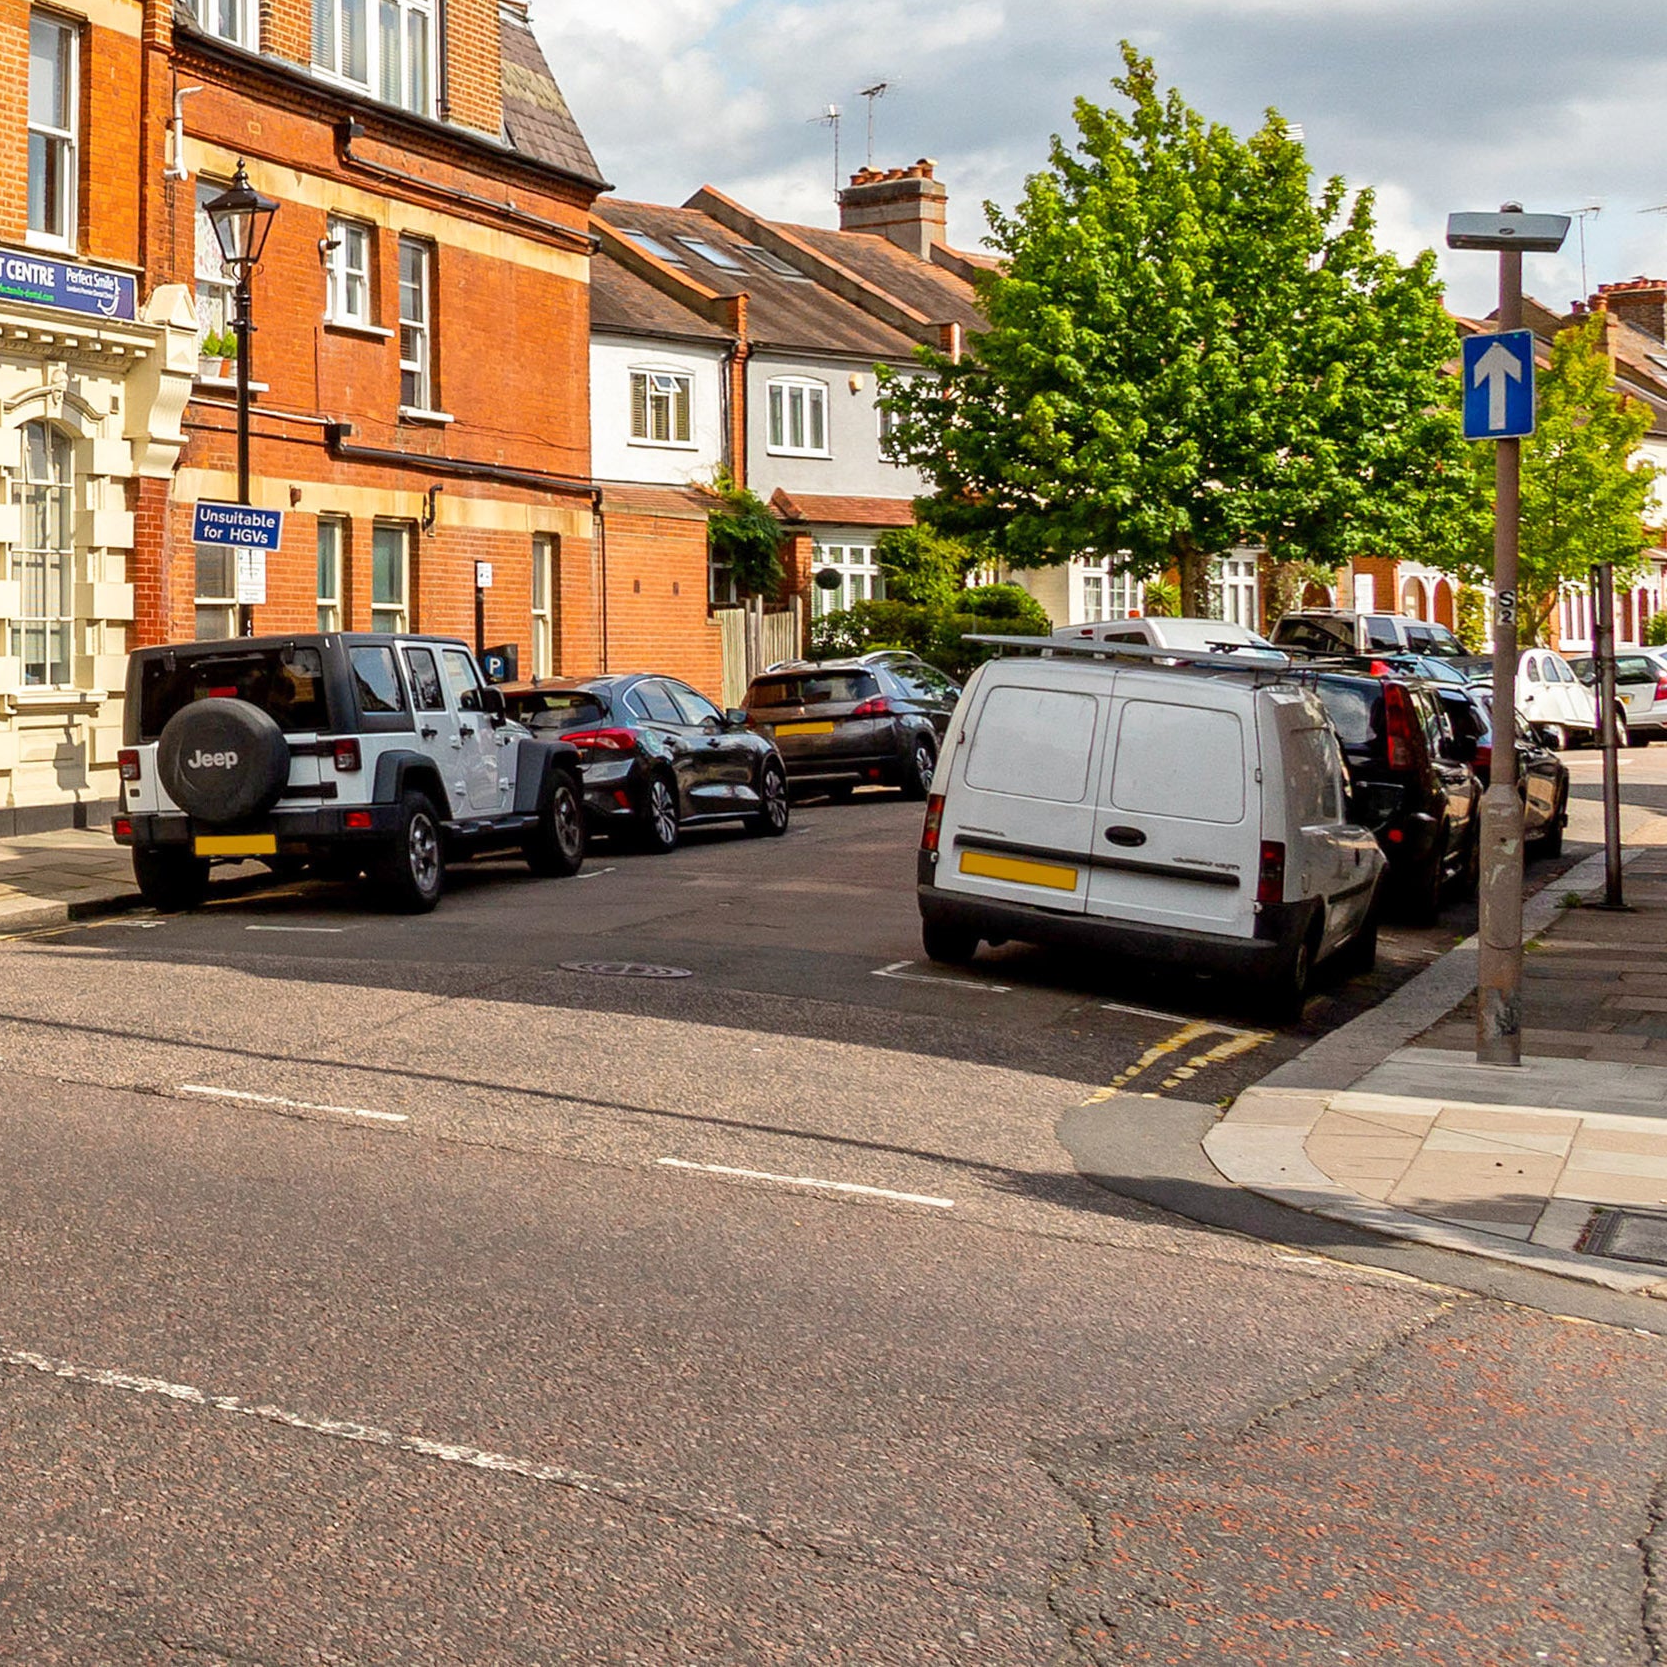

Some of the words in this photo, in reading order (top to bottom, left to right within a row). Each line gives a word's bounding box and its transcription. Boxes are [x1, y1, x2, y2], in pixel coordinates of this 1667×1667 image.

[6, 259, 55, 287] CENTRE
[66, 267, 93, 287] Perfect
[94, 273, 115, 291] Smile
[200, 508, 275, 529] Unsuitable
[203, 525, 223, 539] for
[230, 527, 269, 544] HGVs
[1499, 590, 1514, 607] S
[1501, 610, 1512, 623] 2
[489, 657, 501, 675] P
[187, 749, 238, 770] Jeep
